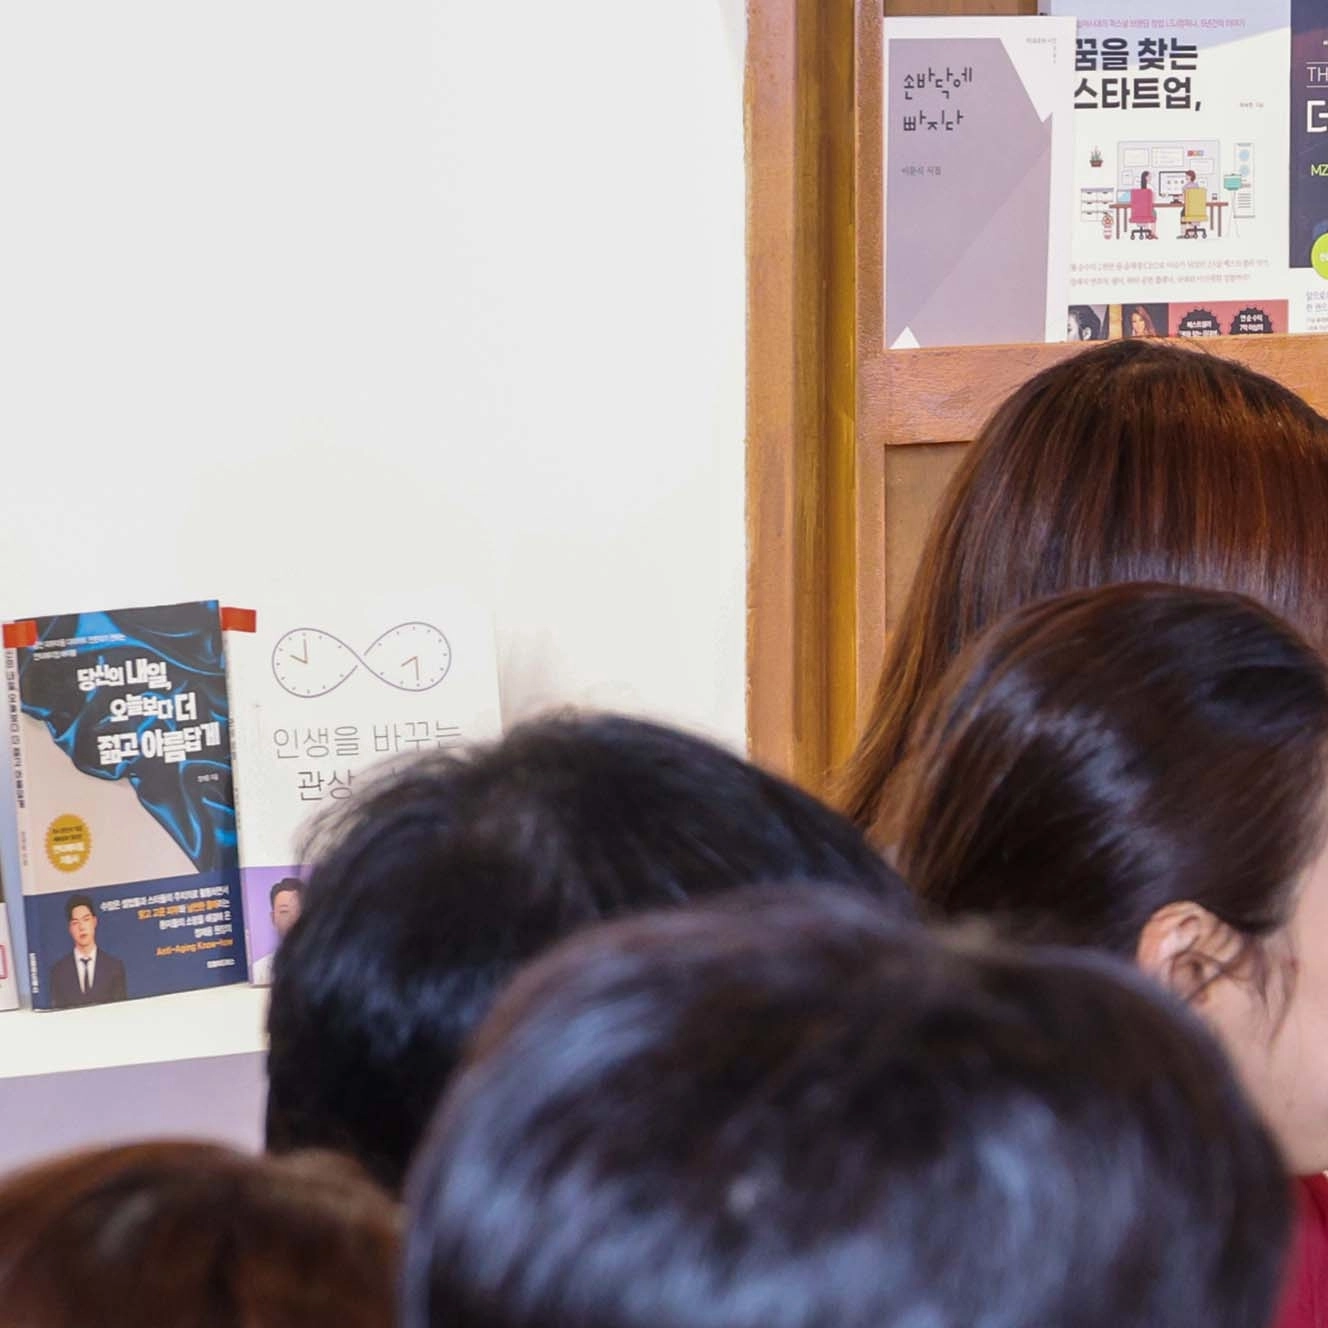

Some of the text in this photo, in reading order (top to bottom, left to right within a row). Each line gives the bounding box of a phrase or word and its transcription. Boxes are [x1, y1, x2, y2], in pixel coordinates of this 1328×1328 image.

[1074, 37, 1130, 71] 꿈을
[1138, 37, 1198, 71] 찾는
[904, 67, 973, 100] 손바닥에
[1074, 77, 1202, 111] 스타트업,
[903, 110, 964, 131] 빠지다
[77, 658, 172, 692] 당신의 내일,
[109, 692, 198, 722] 오늘보다 더
[97, 722, 221, 766] 젊고 아름답게
[273, 720, 462, 759] 인생을 바꾸는
